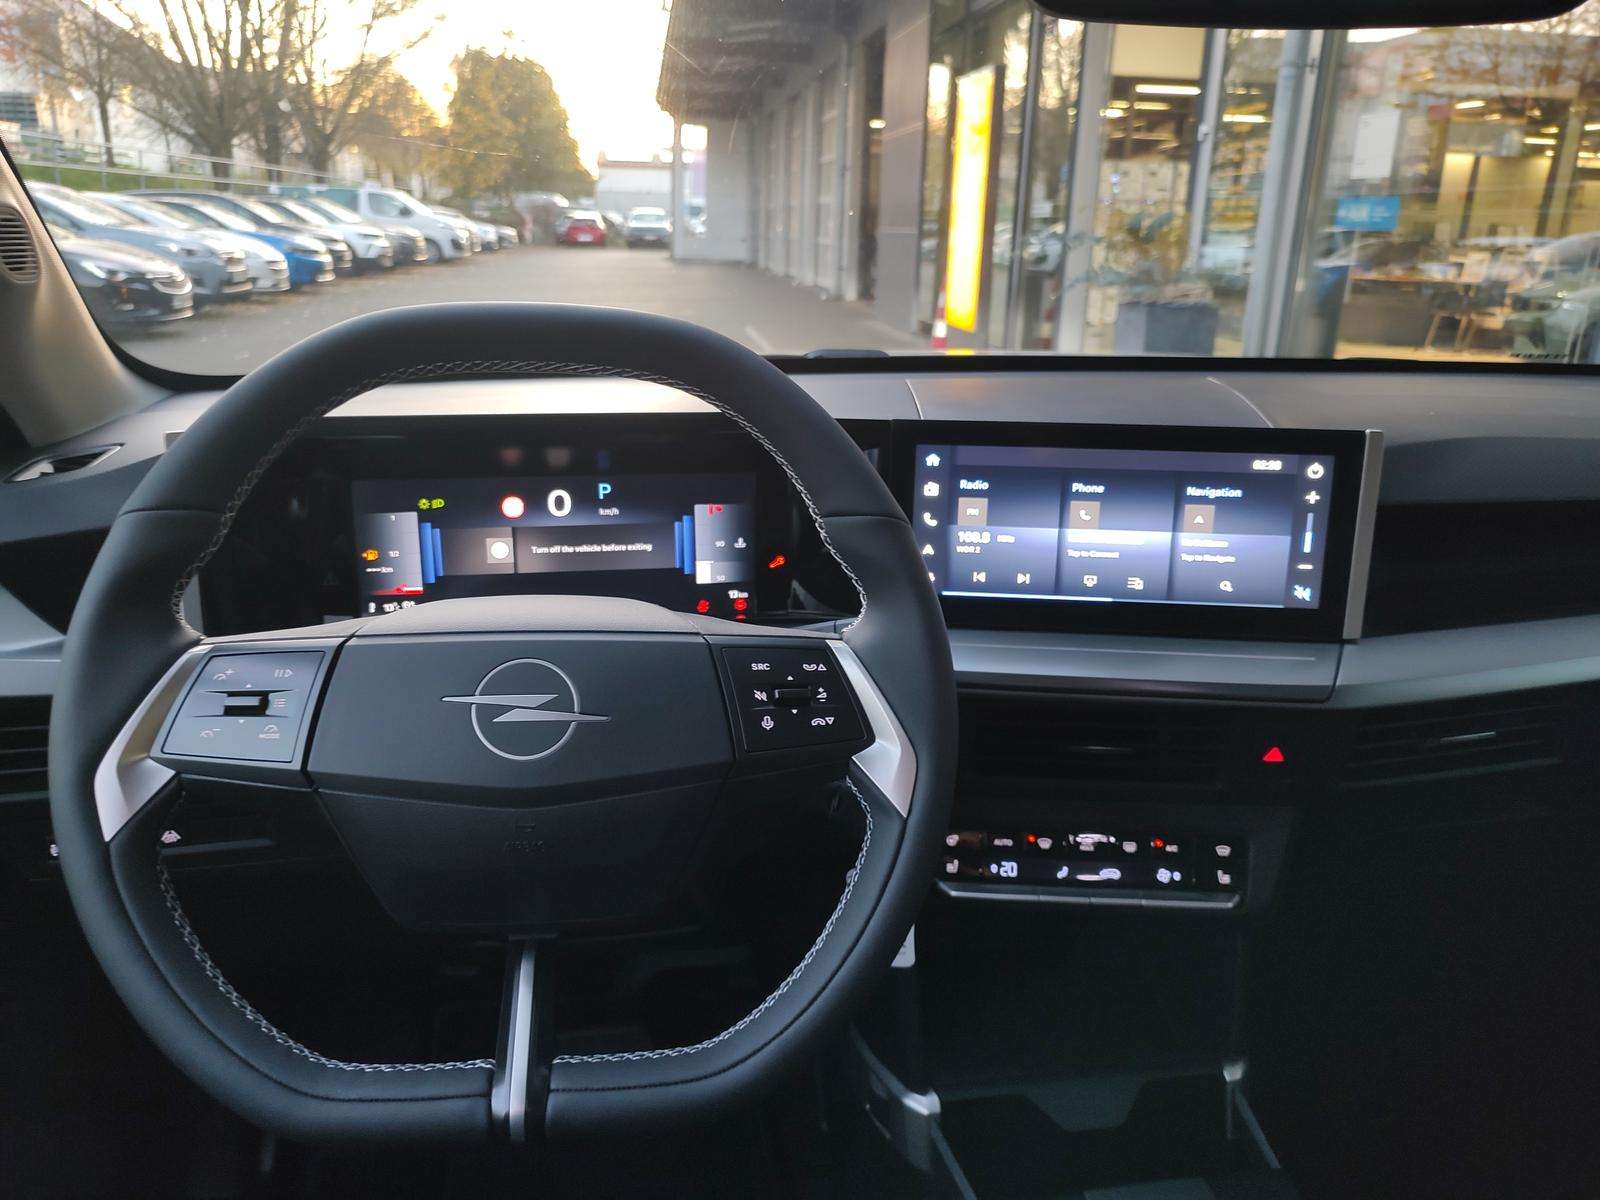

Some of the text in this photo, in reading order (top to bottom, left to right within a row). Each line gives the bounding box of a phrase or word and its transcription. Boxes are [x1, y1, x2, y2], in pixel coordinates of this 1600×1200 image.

[960, 479, 990, 490] Radio
[1072, 482, 1105, 494] Phone
[597, 482, 612, 500] P
[1186, 486, 1243, 499] Navigation
[547, 488, 572, 517] 0
[599, 507, 620, 516] km/h
[531, 543, 653, 555] Turn off the vehicle before exiting
[751, 663, 771, 671] SRC
